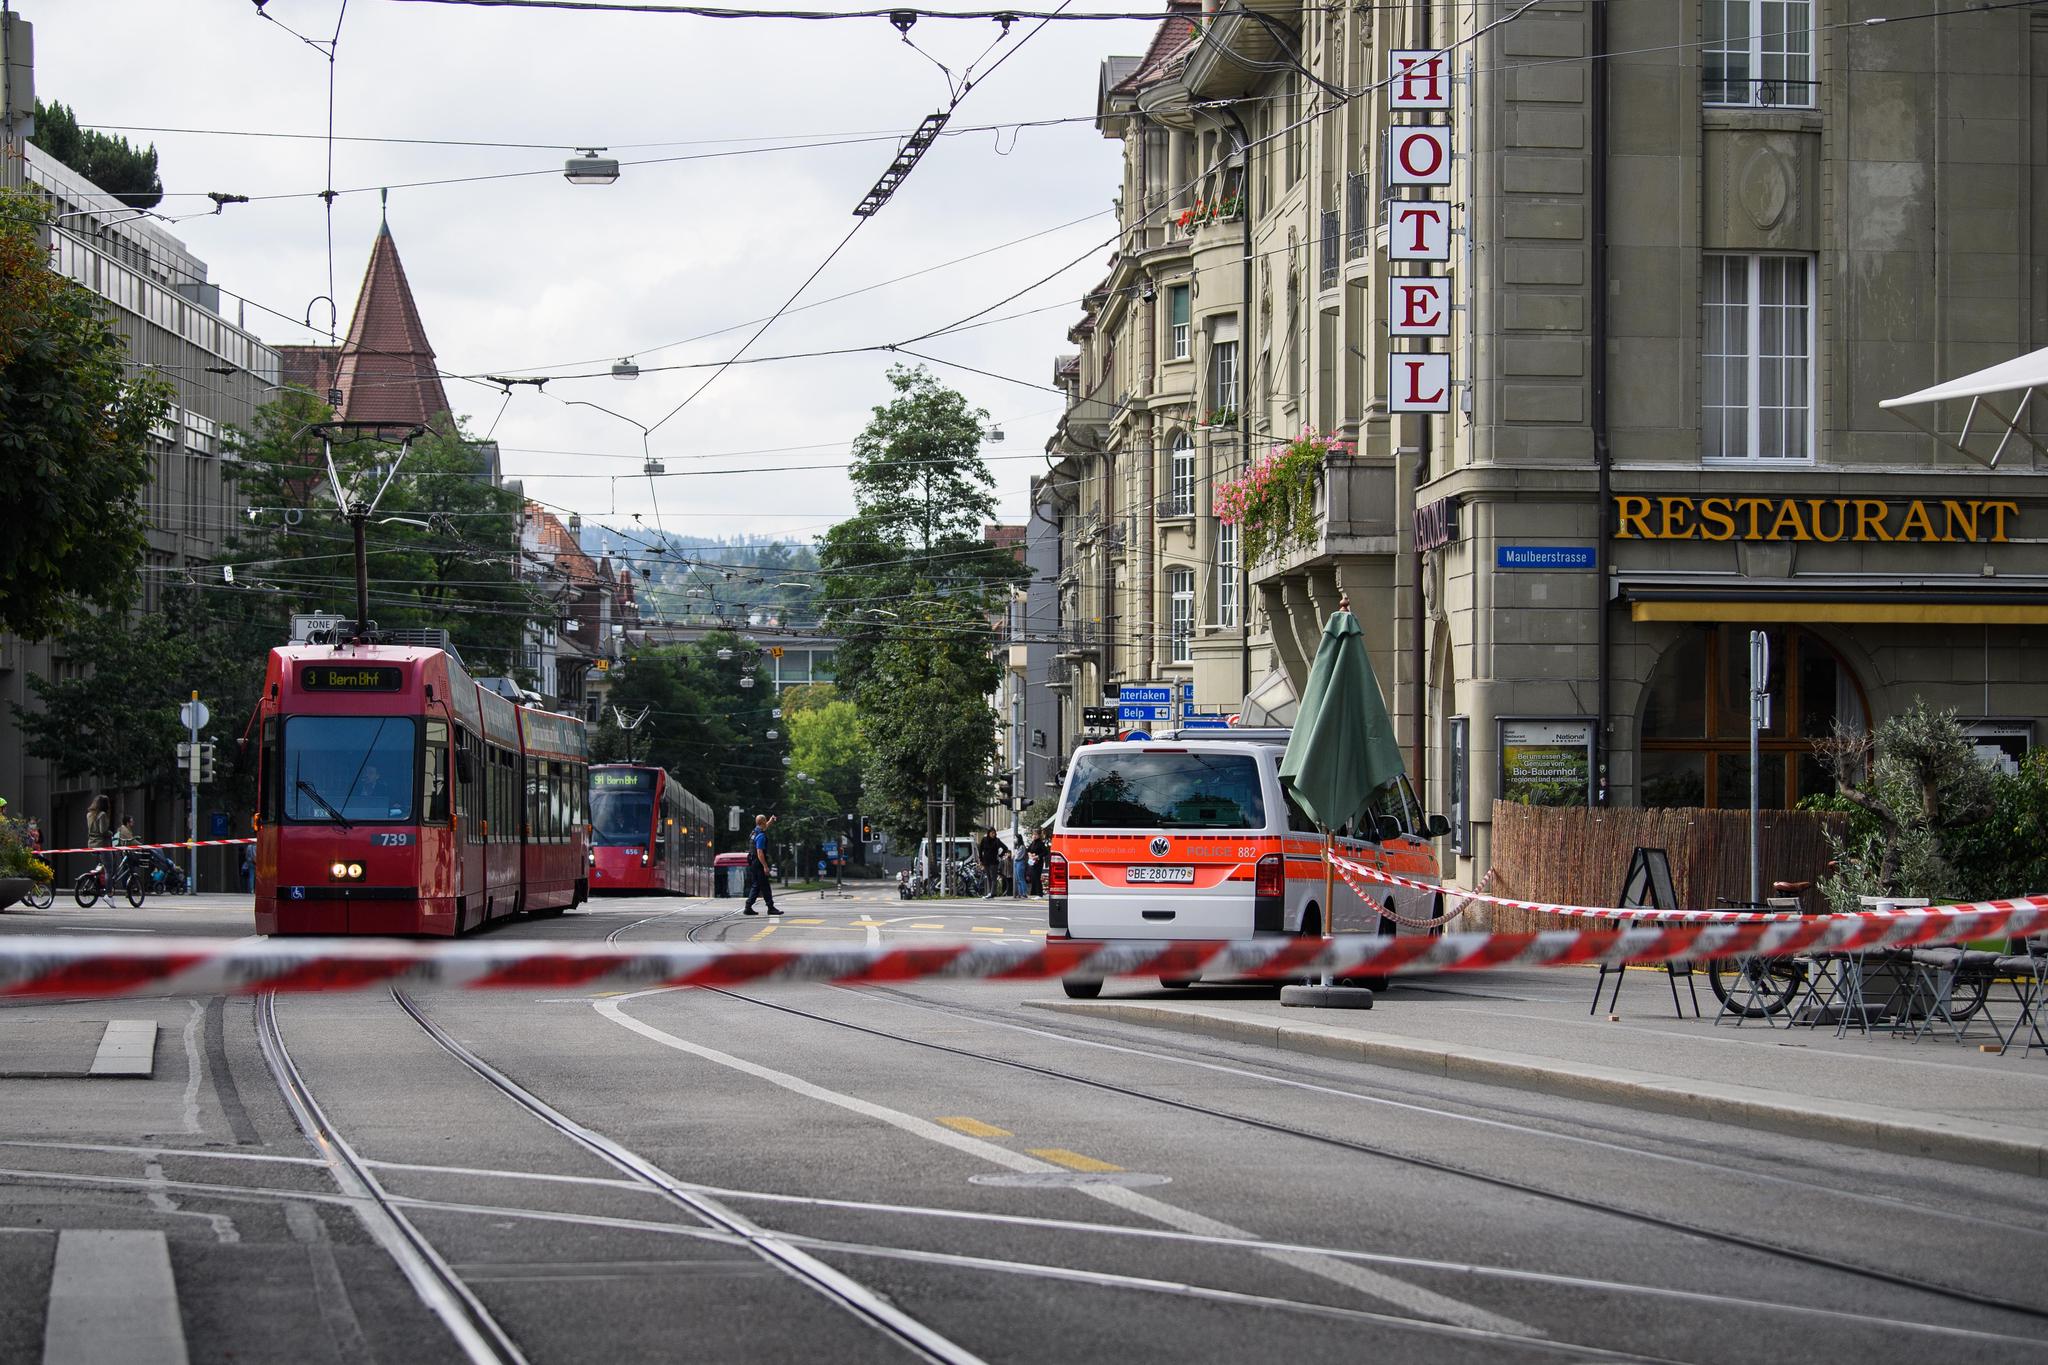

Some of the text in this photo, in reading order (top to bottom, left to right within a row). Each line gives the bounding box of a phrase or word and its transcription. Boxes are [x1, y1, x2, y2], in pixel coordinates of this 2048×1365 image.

[1398, 59, 1444, 403] HOTEL
[1613, 496, 2020, 543] RESTAURANT
[1506, 550, 1587, 563] Maulbeerstrasse
[307, 620, 331, 629] ZONE
[308, 671, 380, 686] 3 Bern Bhf
[1120, 689, 1166, 700] nterlaken
[1124, 708, 1144, 719] Belp
[1513, 767, 1577, 776] Bio-Bauernhof
[606, 775, 624, 785] Bern
[624, 775, 638, 785] Bhf
[381, 833, 407, 846] 739
[1186, 846, 1257, 858] POLICE 882
